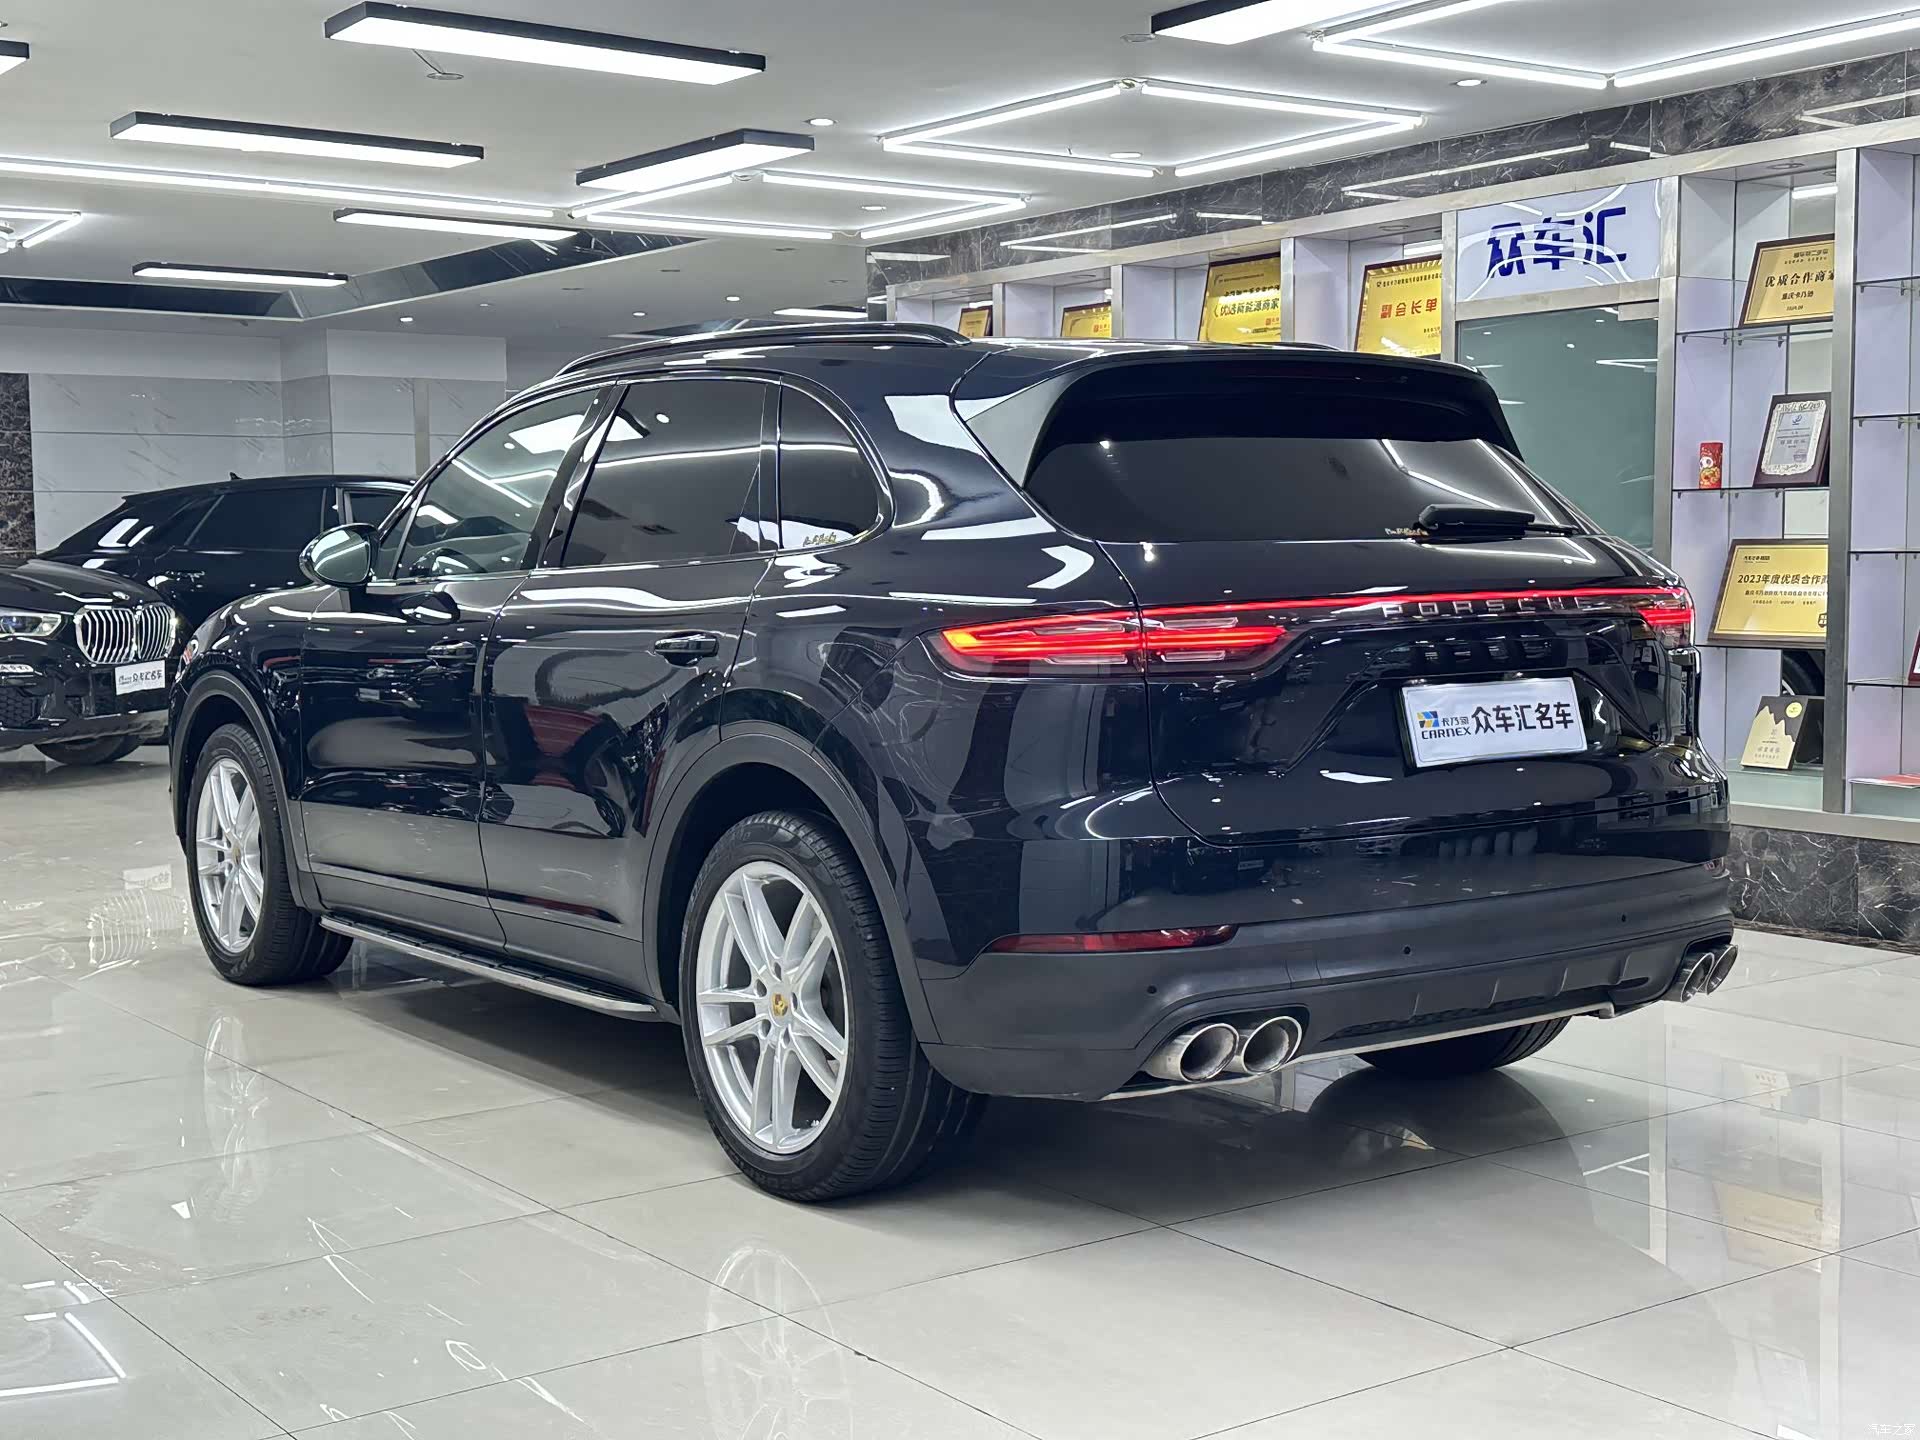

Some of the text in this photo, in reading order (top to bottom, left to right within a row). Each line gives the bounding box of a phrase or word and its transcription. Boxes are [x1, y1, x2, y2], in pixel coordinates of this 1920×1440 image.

[1487, 206, 1627, 279] 众车汇
[1382, 596, 1592, 618] PORSCHE
[1471, 702, 1575, 735] 众车汇名车
[1421, 726, 1472, 740] CARNEX
